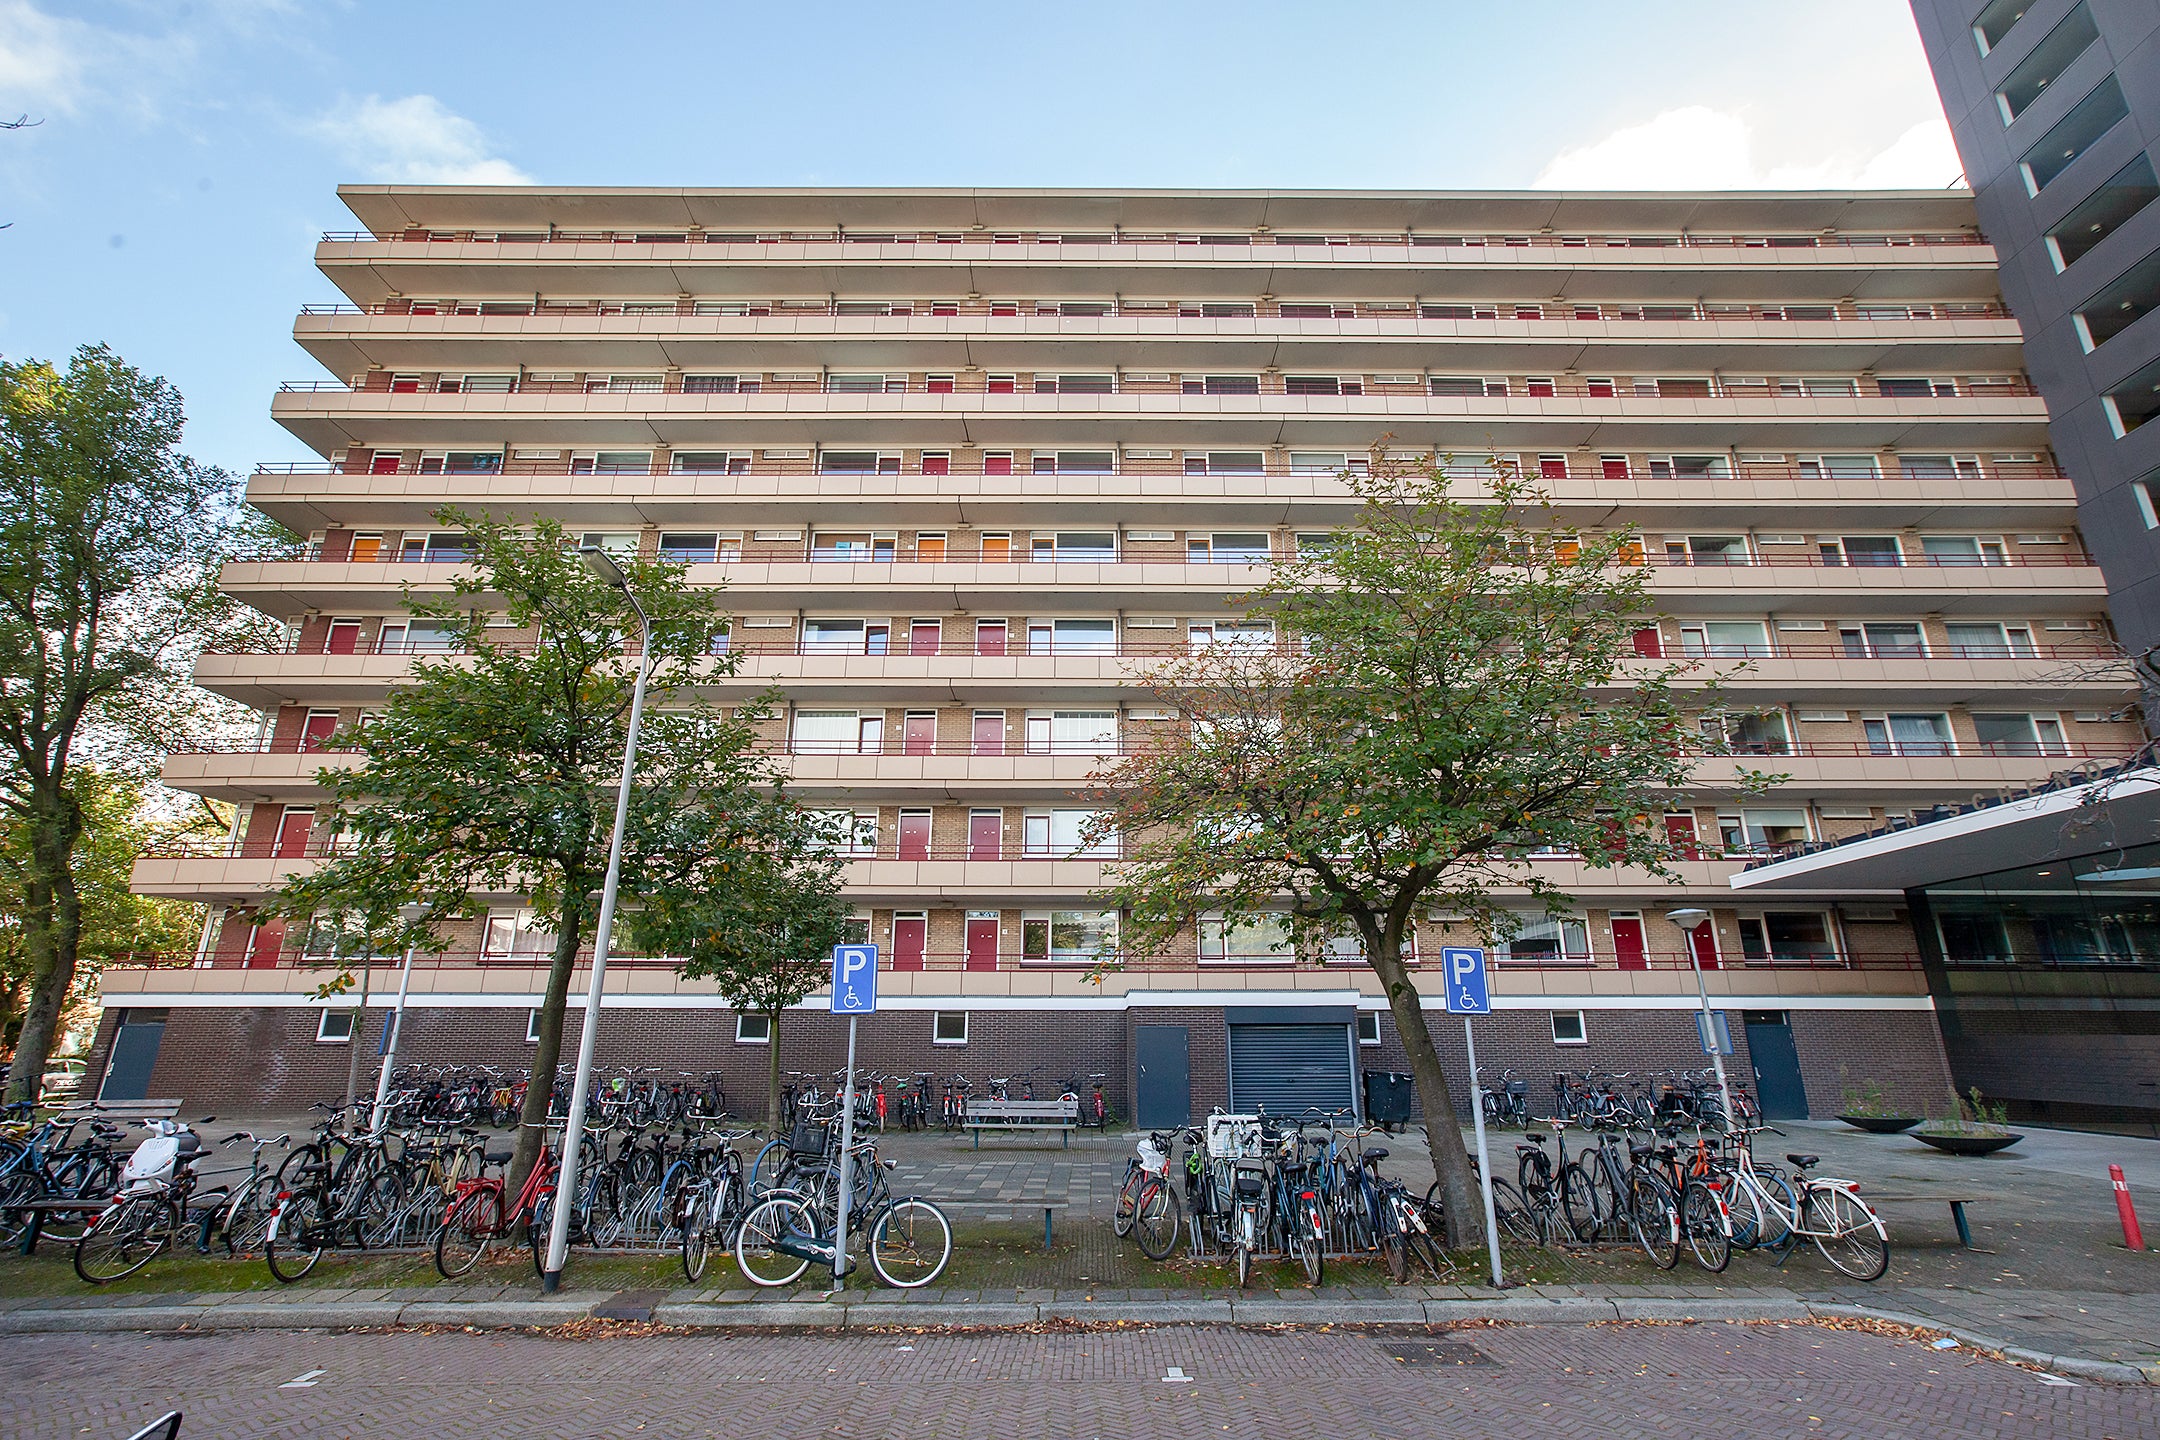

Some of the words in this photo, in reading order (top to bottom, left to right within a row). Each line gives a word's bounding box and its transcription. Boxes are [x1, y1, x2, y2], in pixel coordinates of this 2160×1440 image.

[1751, 833, 1840, 869] ARTHUR
[1862, 811, 1918, 838] VAN
[843, 950, 867, 984] P
[1452, 953, 1476, 985] P
